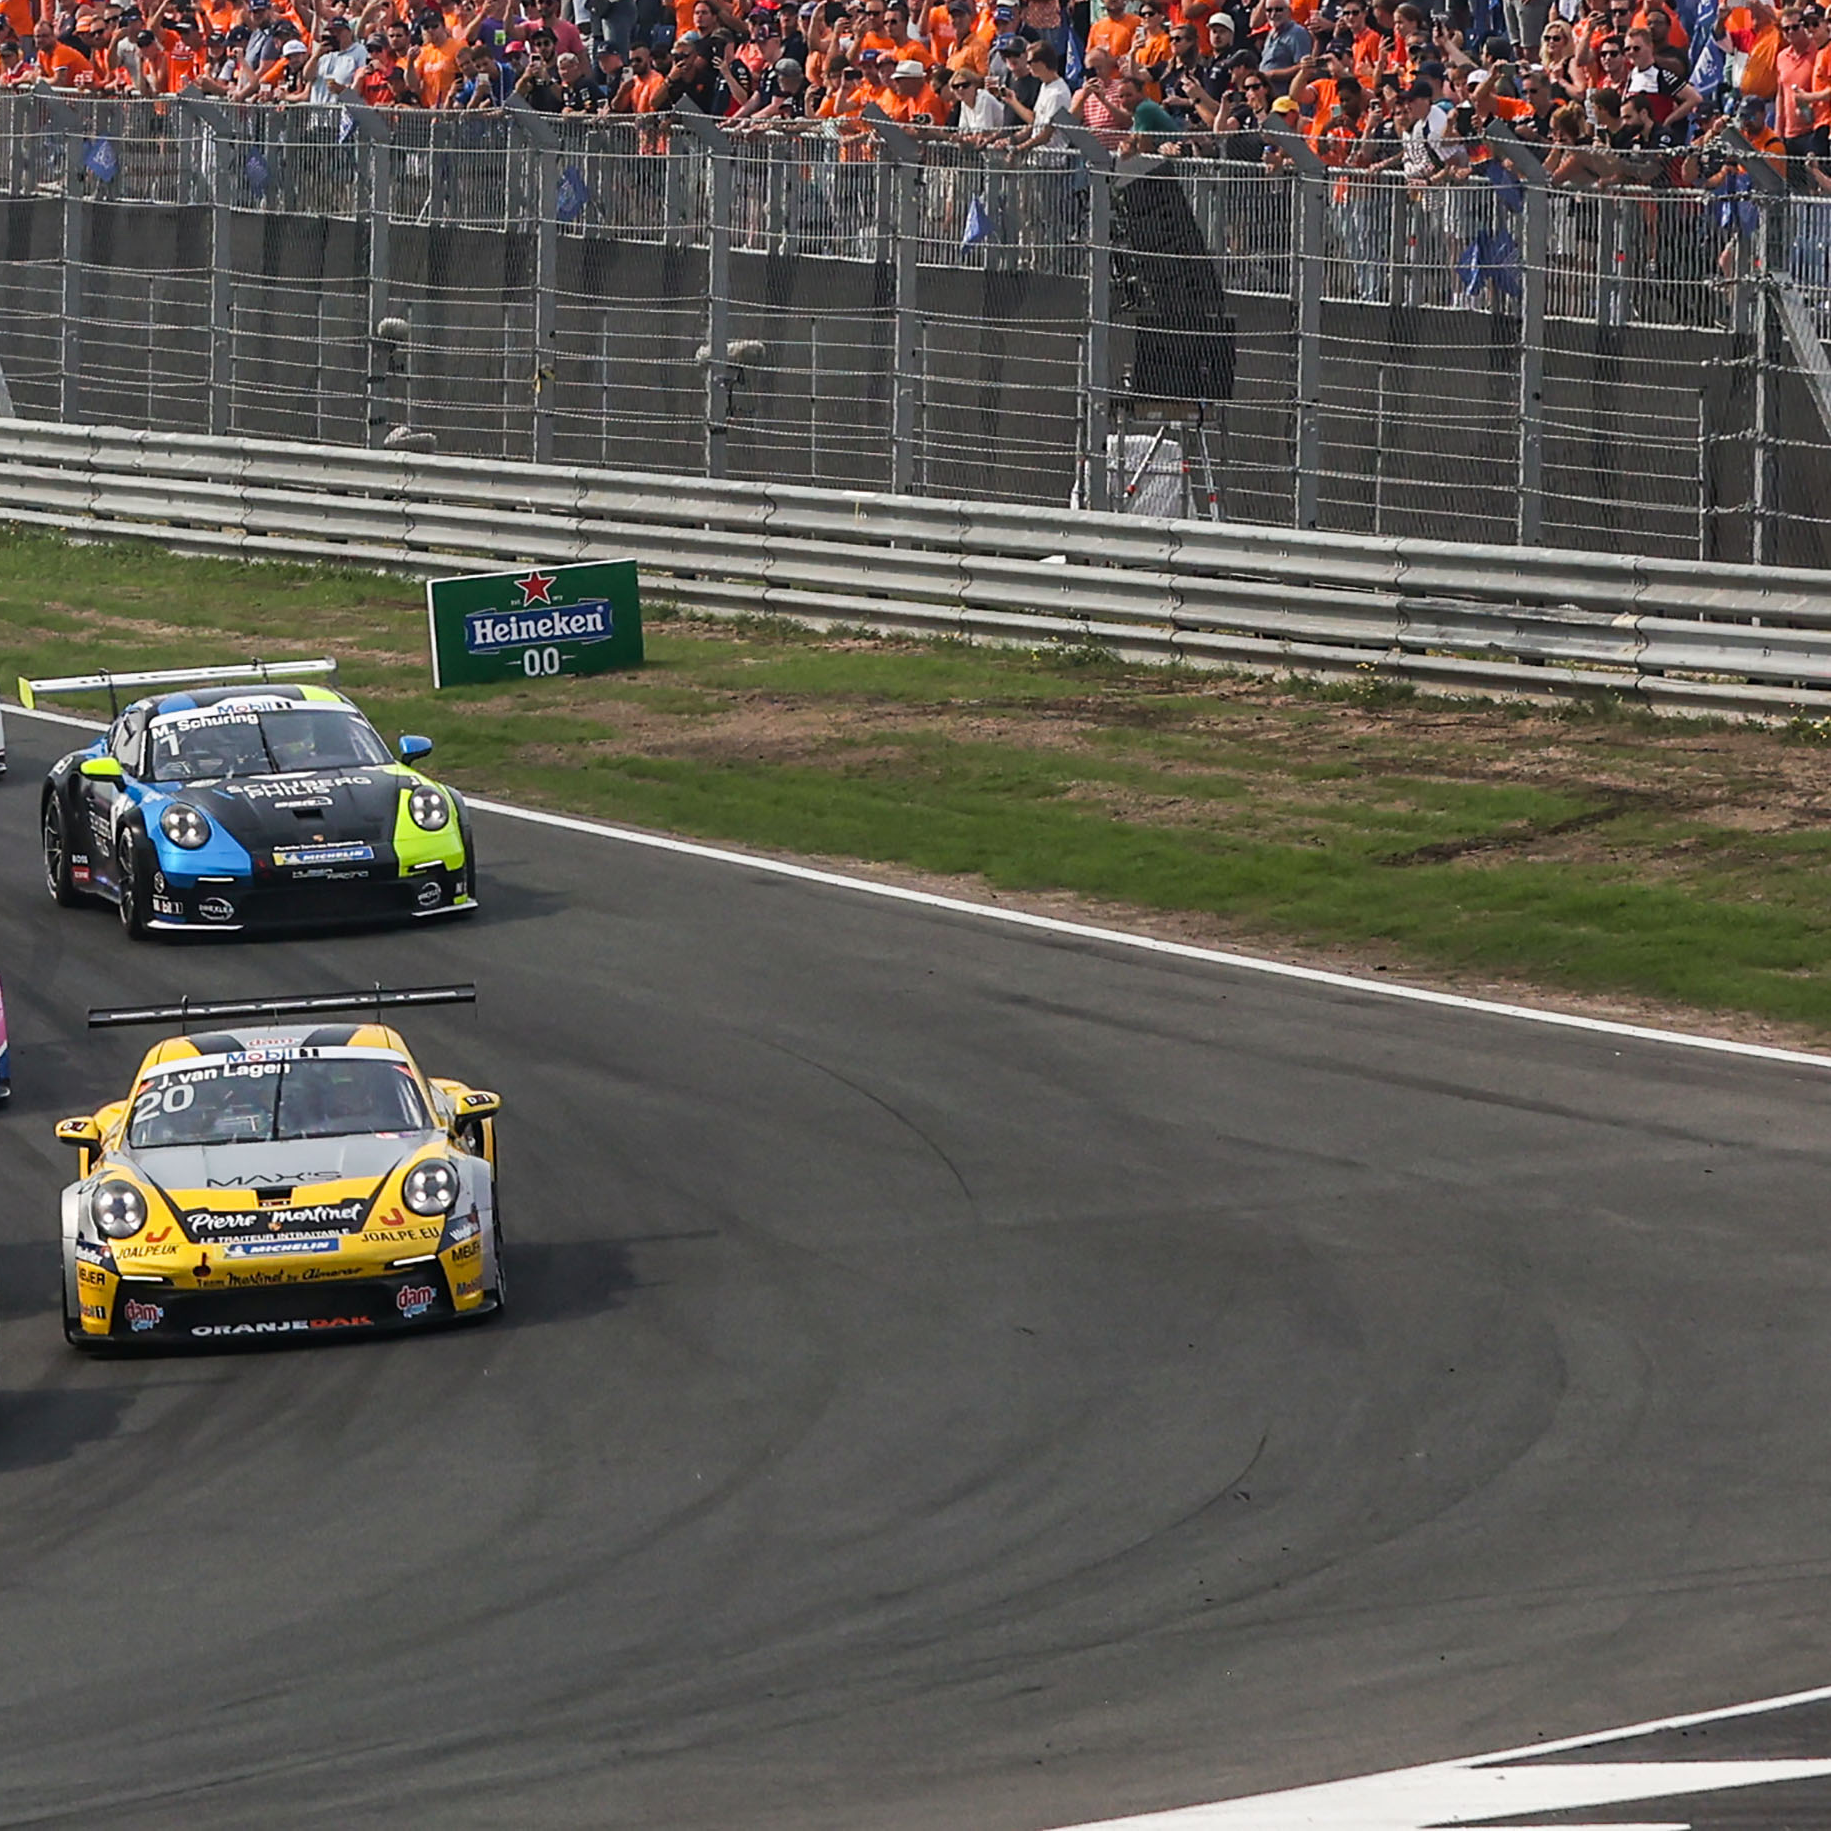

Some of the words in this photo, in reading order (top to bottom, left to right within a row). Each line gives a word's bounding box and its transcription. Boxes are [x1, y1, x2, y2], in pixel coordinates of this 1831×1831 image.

[472, 611, 605, 646] Heineken
[523, 646, 560, 678] 0.0
[217, 701, 274, 715] Mobil
[151, 723, 175, 740] M.
[177, 712, 259, 733] Schuring
[160, 733, 181, 757] 1
[225, 776, 372, 794] SCHUBERG
[303, 850, 365, 861] MICHELIN
[226, 1048, 294, 1062] Mobil
[157, 1073, 172, 1090] J.
[173, 1066, 219, 1083] van
[222, 1060, 291, 1078] Lagen
[134, 1083, 196, 1123] 20
[206, 1170, 343, 1188] MAX'S
[187, 1212, 258, 1234] Pierre
[199, 1236, 215, 1244] LE
[216, 1233, 274, 1244] TRAITEUR
[275, 1228, 350, 1241] INTRAITABLE
[361, 1227, 440, 1243] JOALPE.EU
[249, 1241, 330, 1254] MICHELIN
